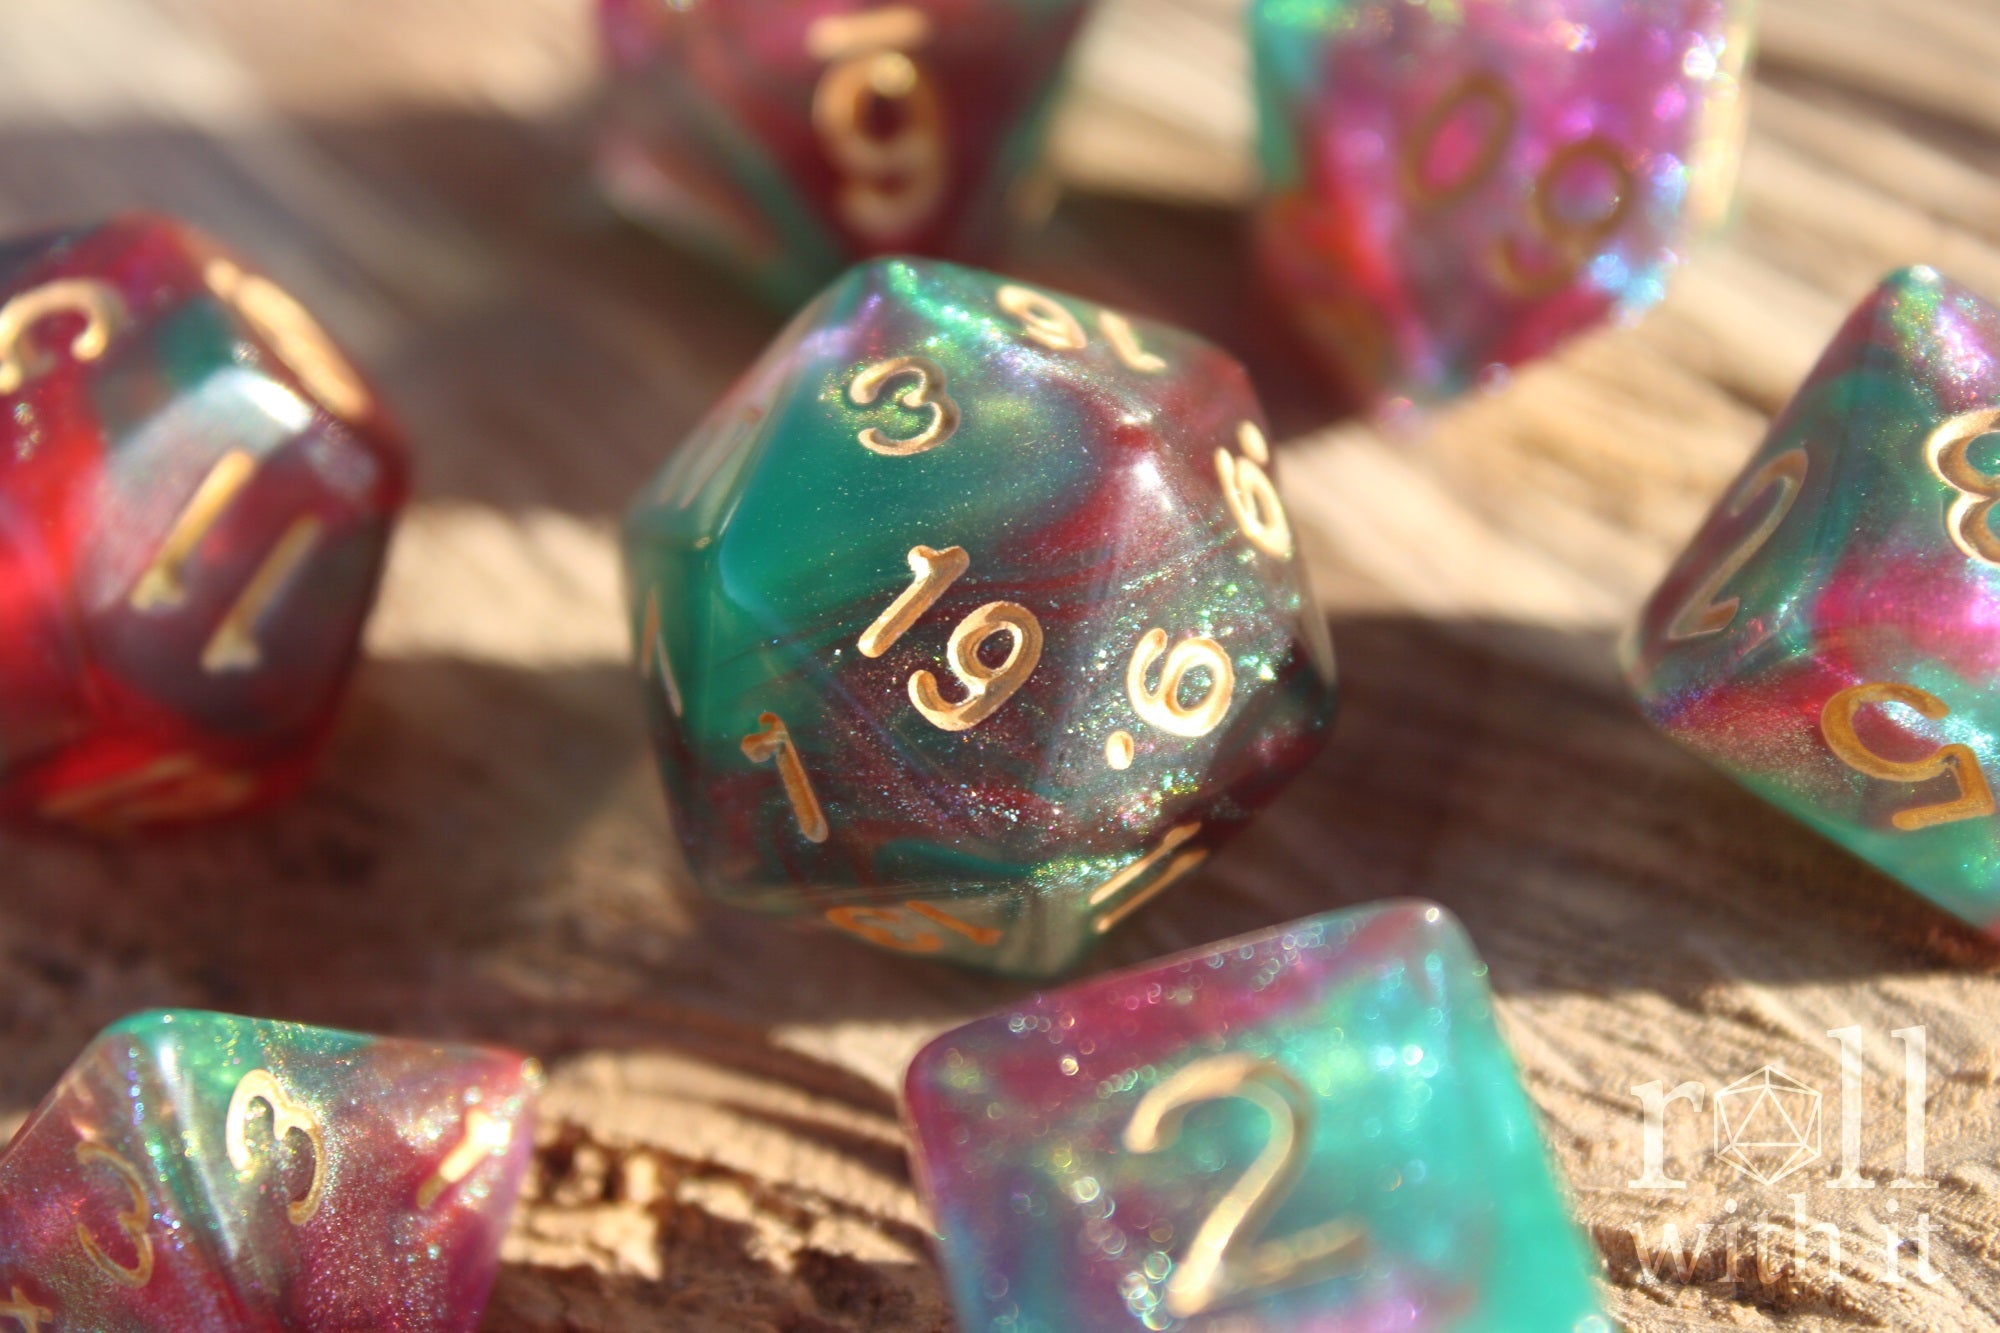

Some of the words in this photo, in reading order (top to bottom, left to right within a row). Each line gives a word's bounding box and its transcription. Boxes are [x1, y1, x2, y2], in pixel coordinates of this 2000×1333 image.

[850, 356, 960, 457] 3
[857, 545, 1044, 732] 19
[226, 1068, 326, 1226] 3
[1123, 1053, 1372, 1318] 2
